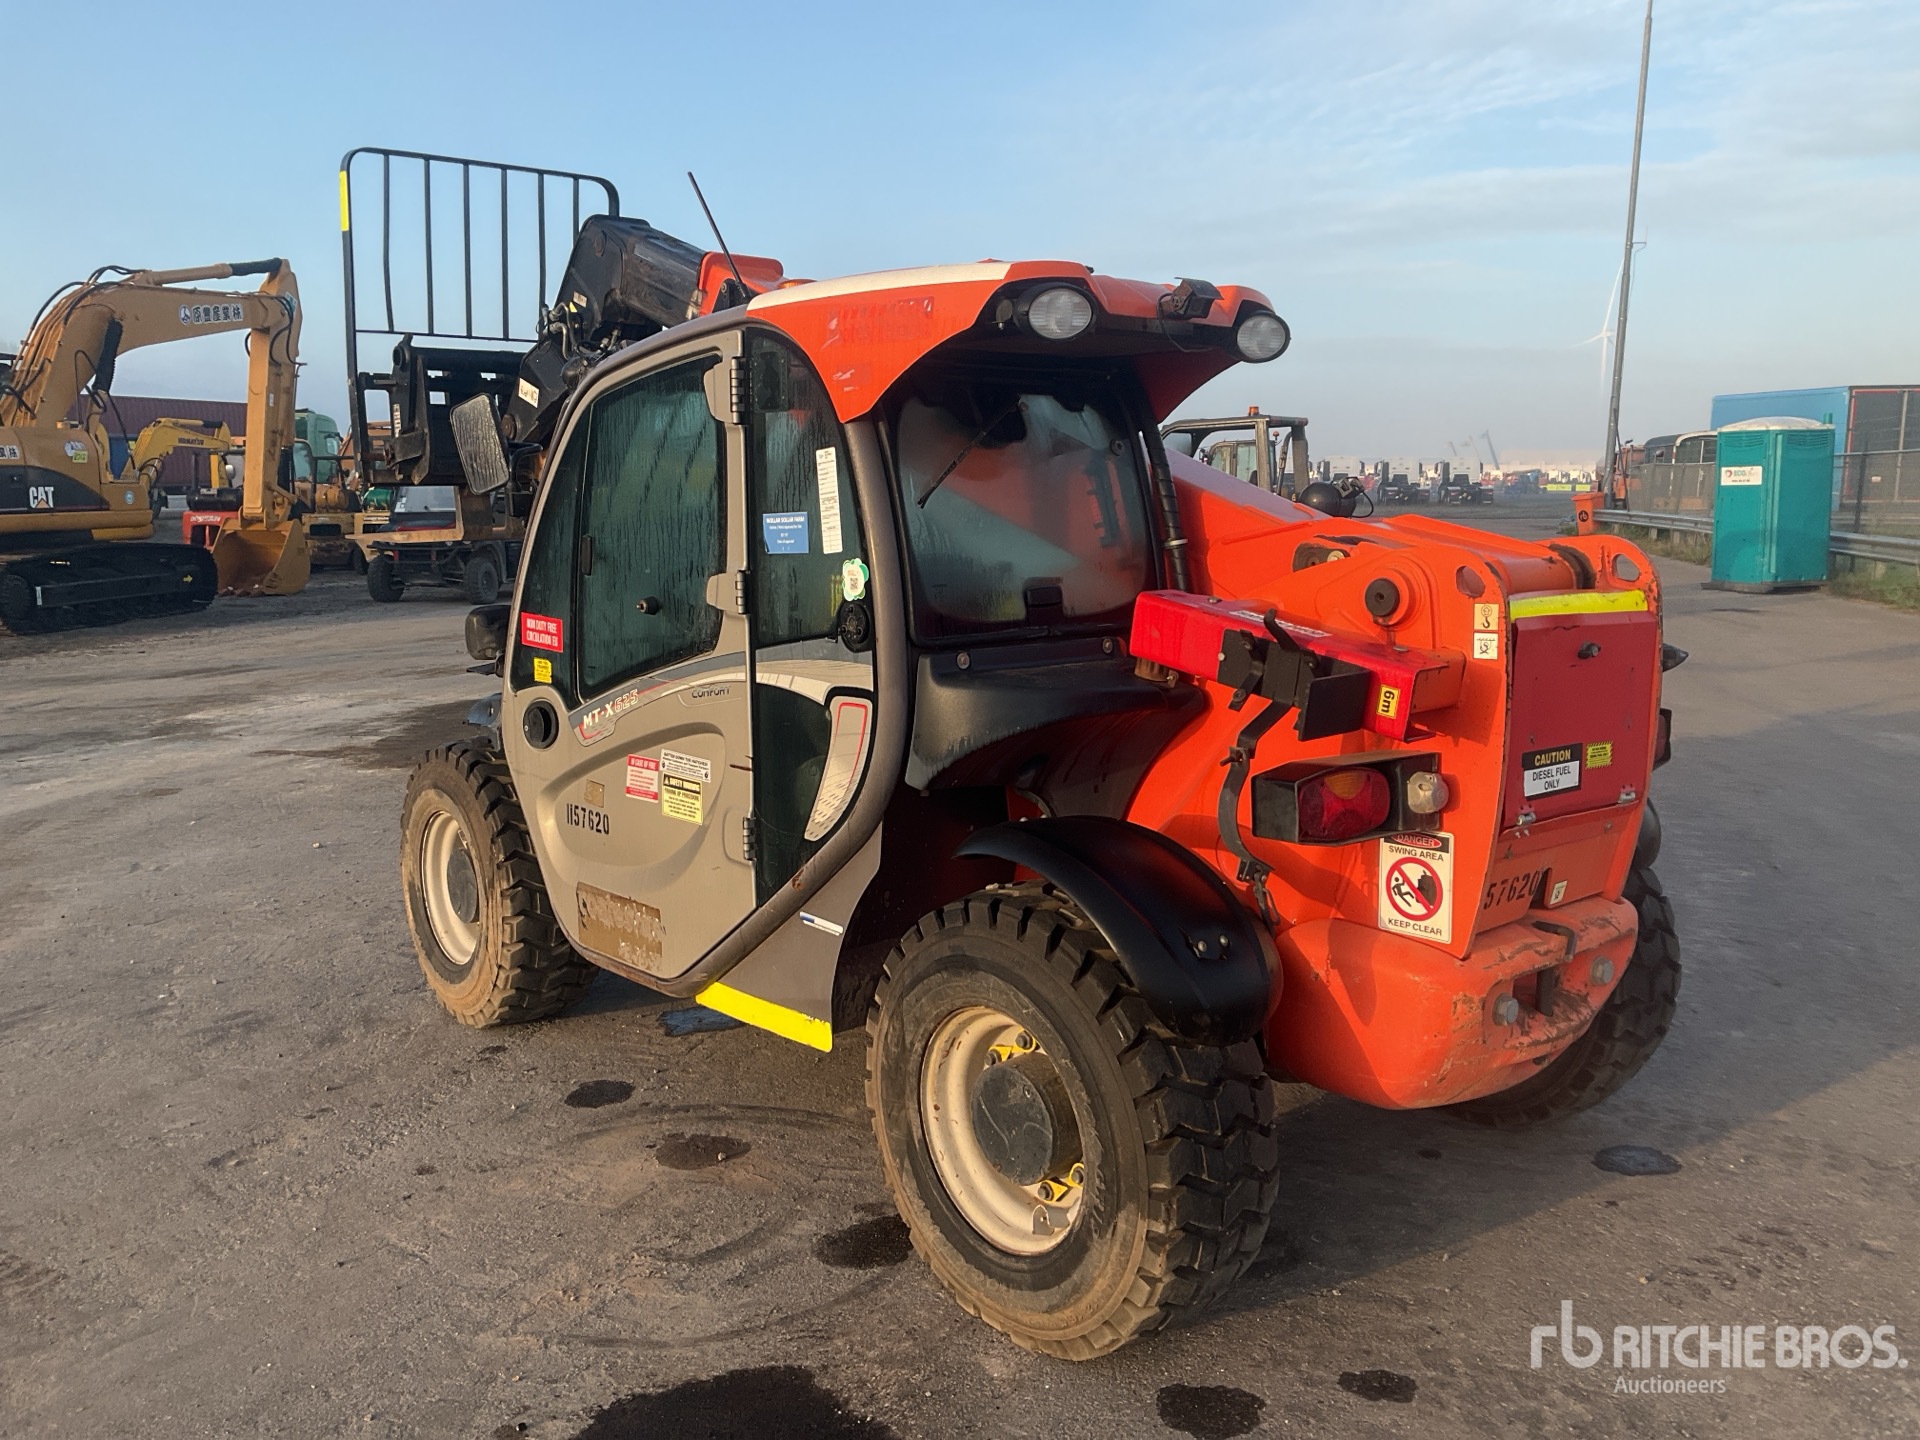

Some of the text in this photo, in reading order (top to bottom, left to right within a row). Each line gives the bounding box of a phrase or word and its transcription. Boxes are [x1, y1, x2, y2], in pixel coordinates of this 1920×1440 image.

[29, 486, 54, 508] CAT
[547, 622, 557, 634] FREE
[614, 689, 639, 712] 625
[1381, 690, 1395, 713] 6m
[1534, 749, 1571, 766] CAUTION
[1532, 765, 1571, 781] DIESEL FUEL
[1544, 778, 1560, 790] ONLY
[1397, 834, 1435, 847] DANGER
[1389, 845, 1444, 861] SWING AREA
[1483, 870, 1540, 910] 57620
[1388, 917, 1442, 936] KEEP CLEAR
